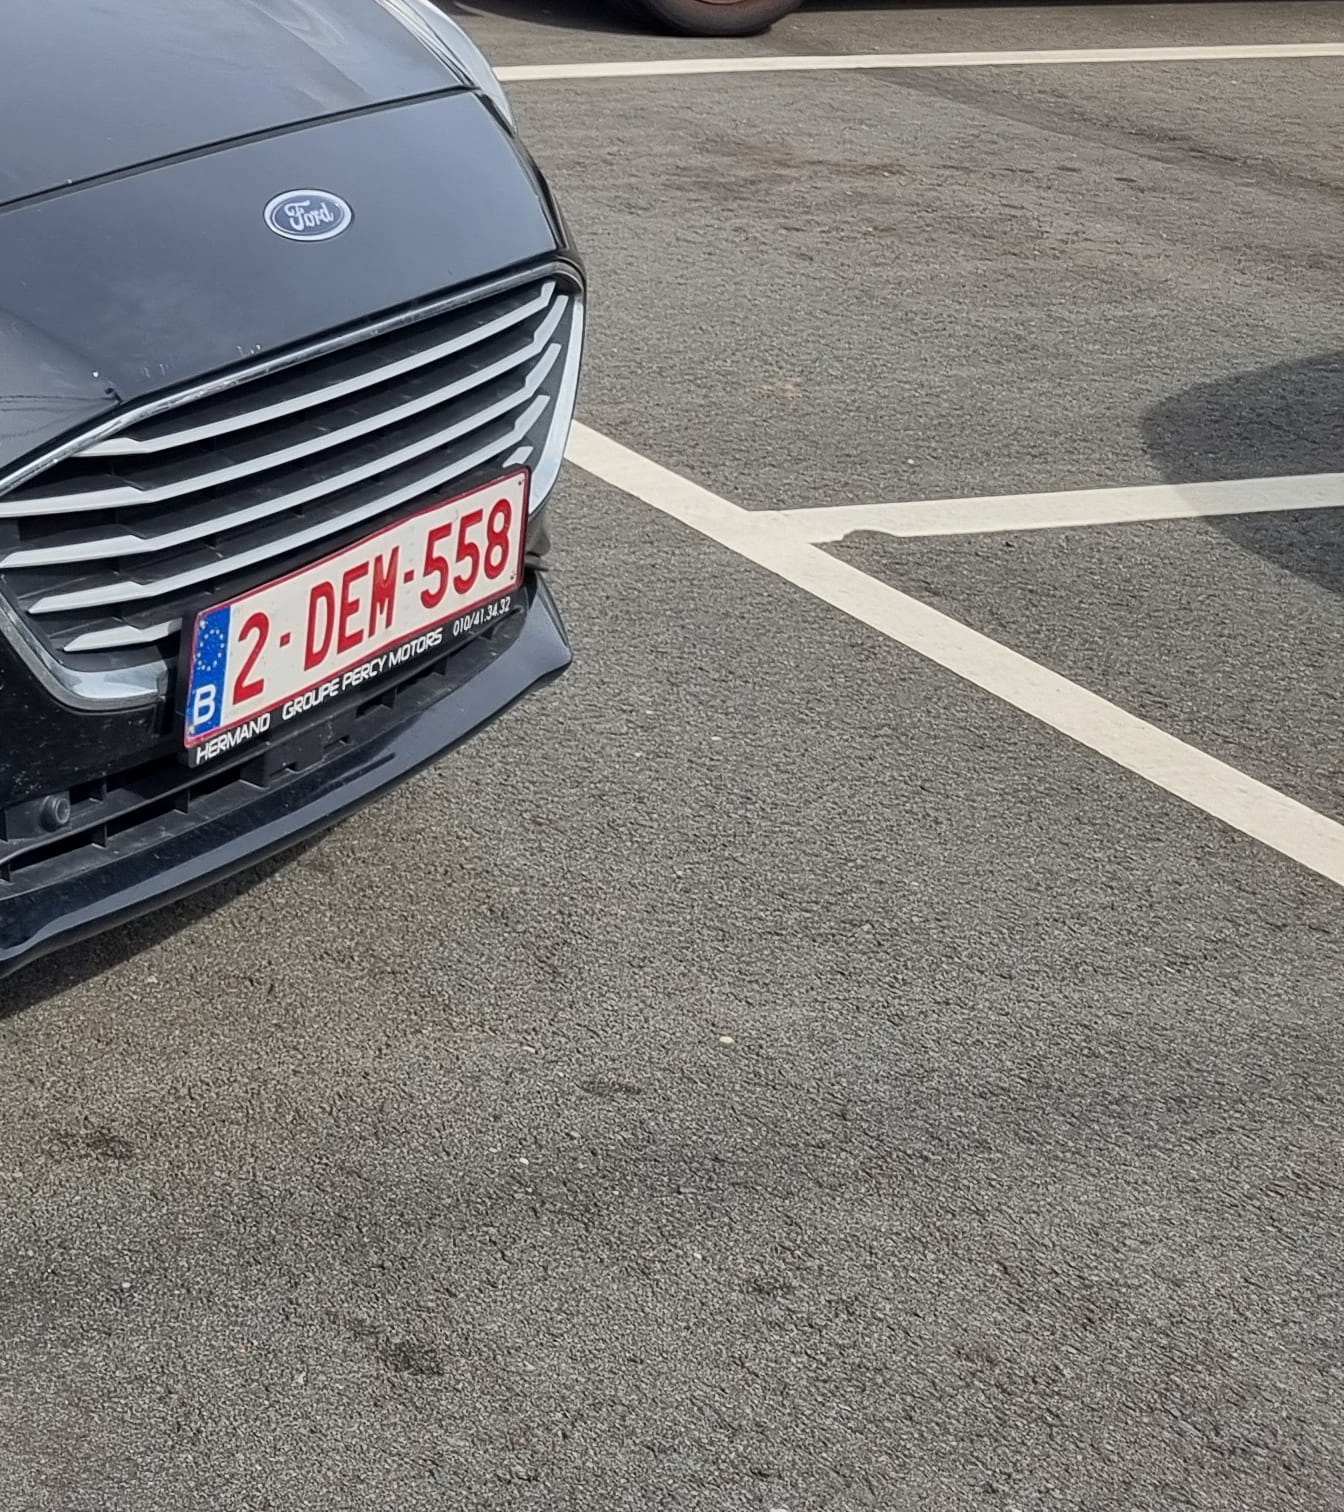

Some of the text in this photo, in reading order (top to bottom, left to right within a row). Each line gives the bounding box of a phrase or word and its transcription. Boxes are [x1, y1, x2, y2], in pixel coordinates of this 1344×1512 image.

[284, 199, 334, 231] Ford
[232, 498, 512, 705] 2-DEM-558
[193, 684, 216, 726] B
[196, 596, 511, 765] HERMAND GROUPE PERCY MOTORS 010/41.34.32
